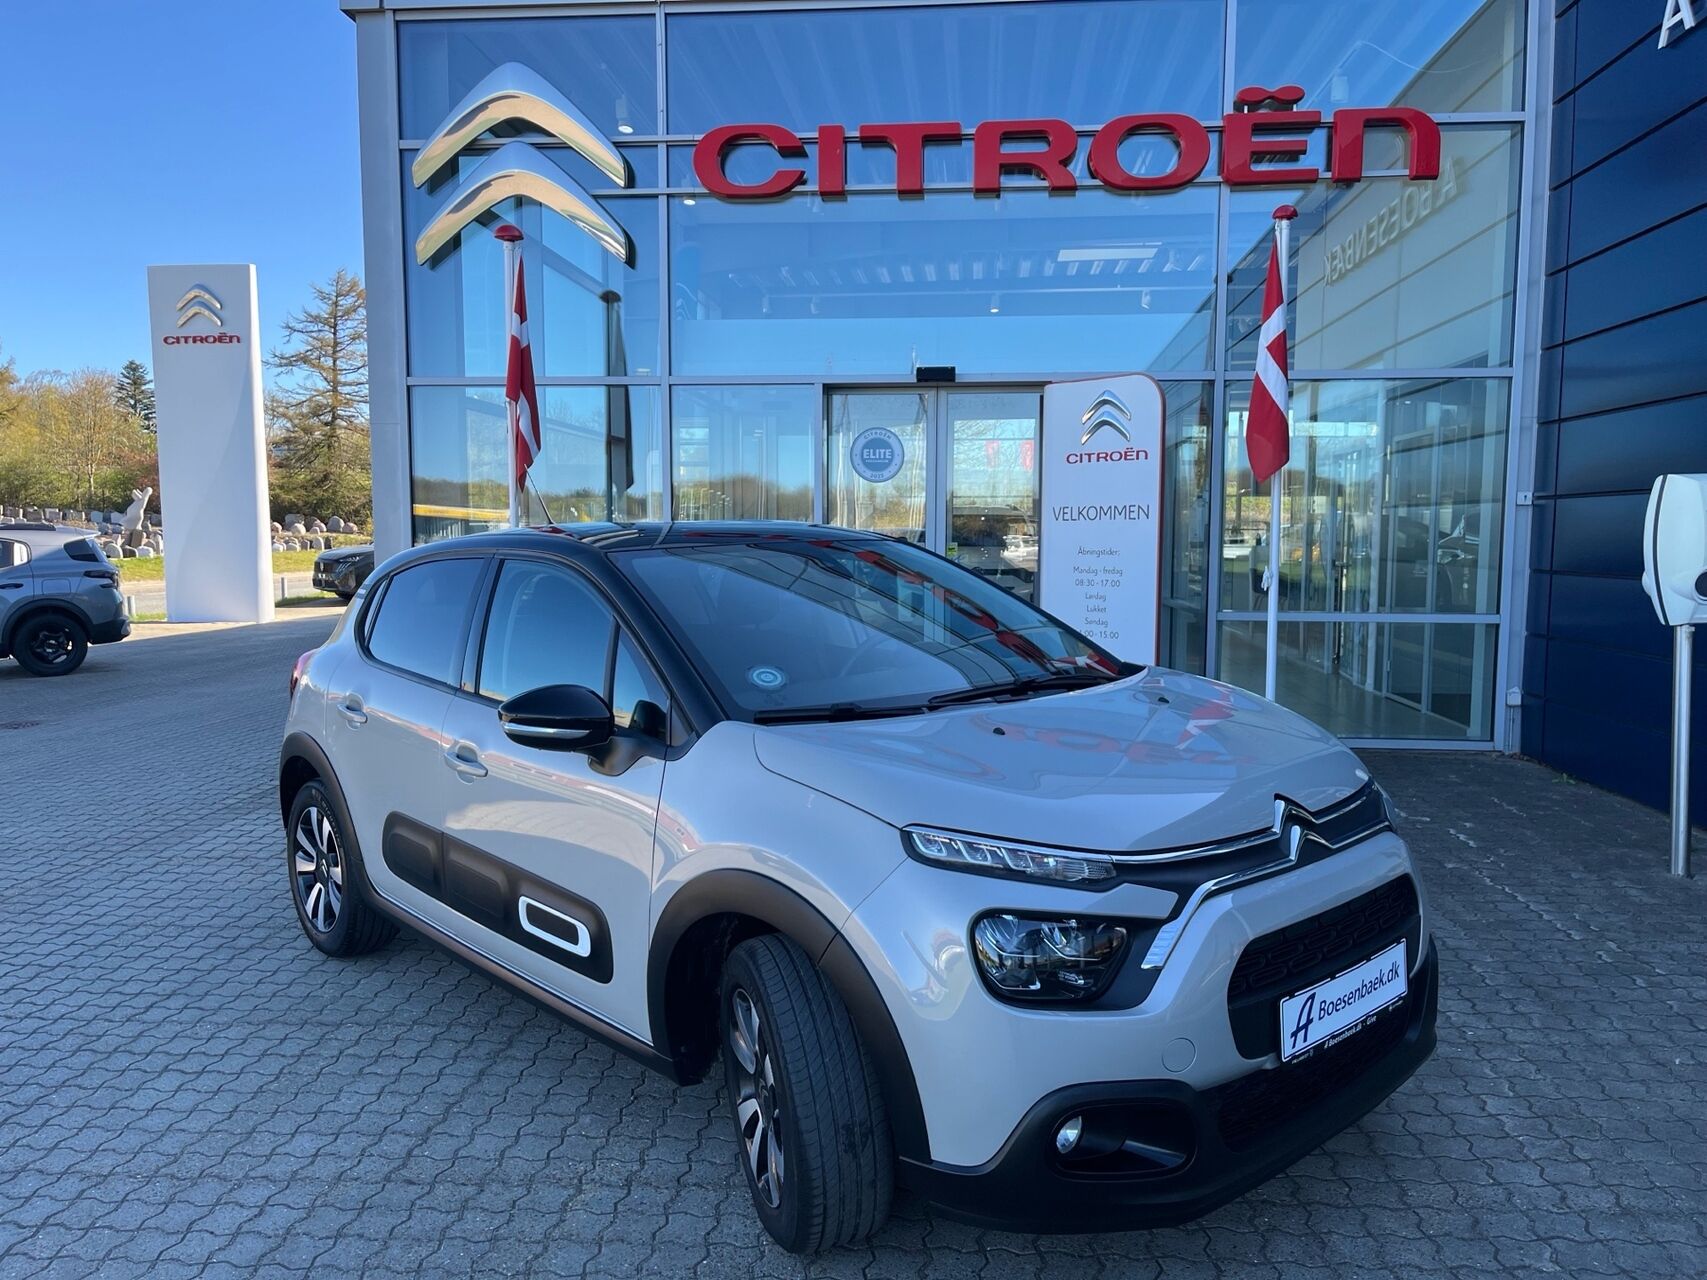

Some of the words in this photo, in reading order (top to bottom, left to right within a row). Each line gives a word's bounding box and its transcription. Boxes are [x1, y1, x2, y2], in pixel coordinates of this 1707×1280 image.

[692, 85, 1441, 198] CITROËN
[163, 332, 241, 345] CITROËN
[863, 449, 892, 459] ELITE
[1066, 447, 1148, 464] CITROËN
[1053, 504, 1150, 521] VELKOMMEN
[1073, 566, 1098, 576] Mandag
[1103, 566, 1123, 577] fredag
[1318, 961, 1400, 1021] Boesenbaek.dk
